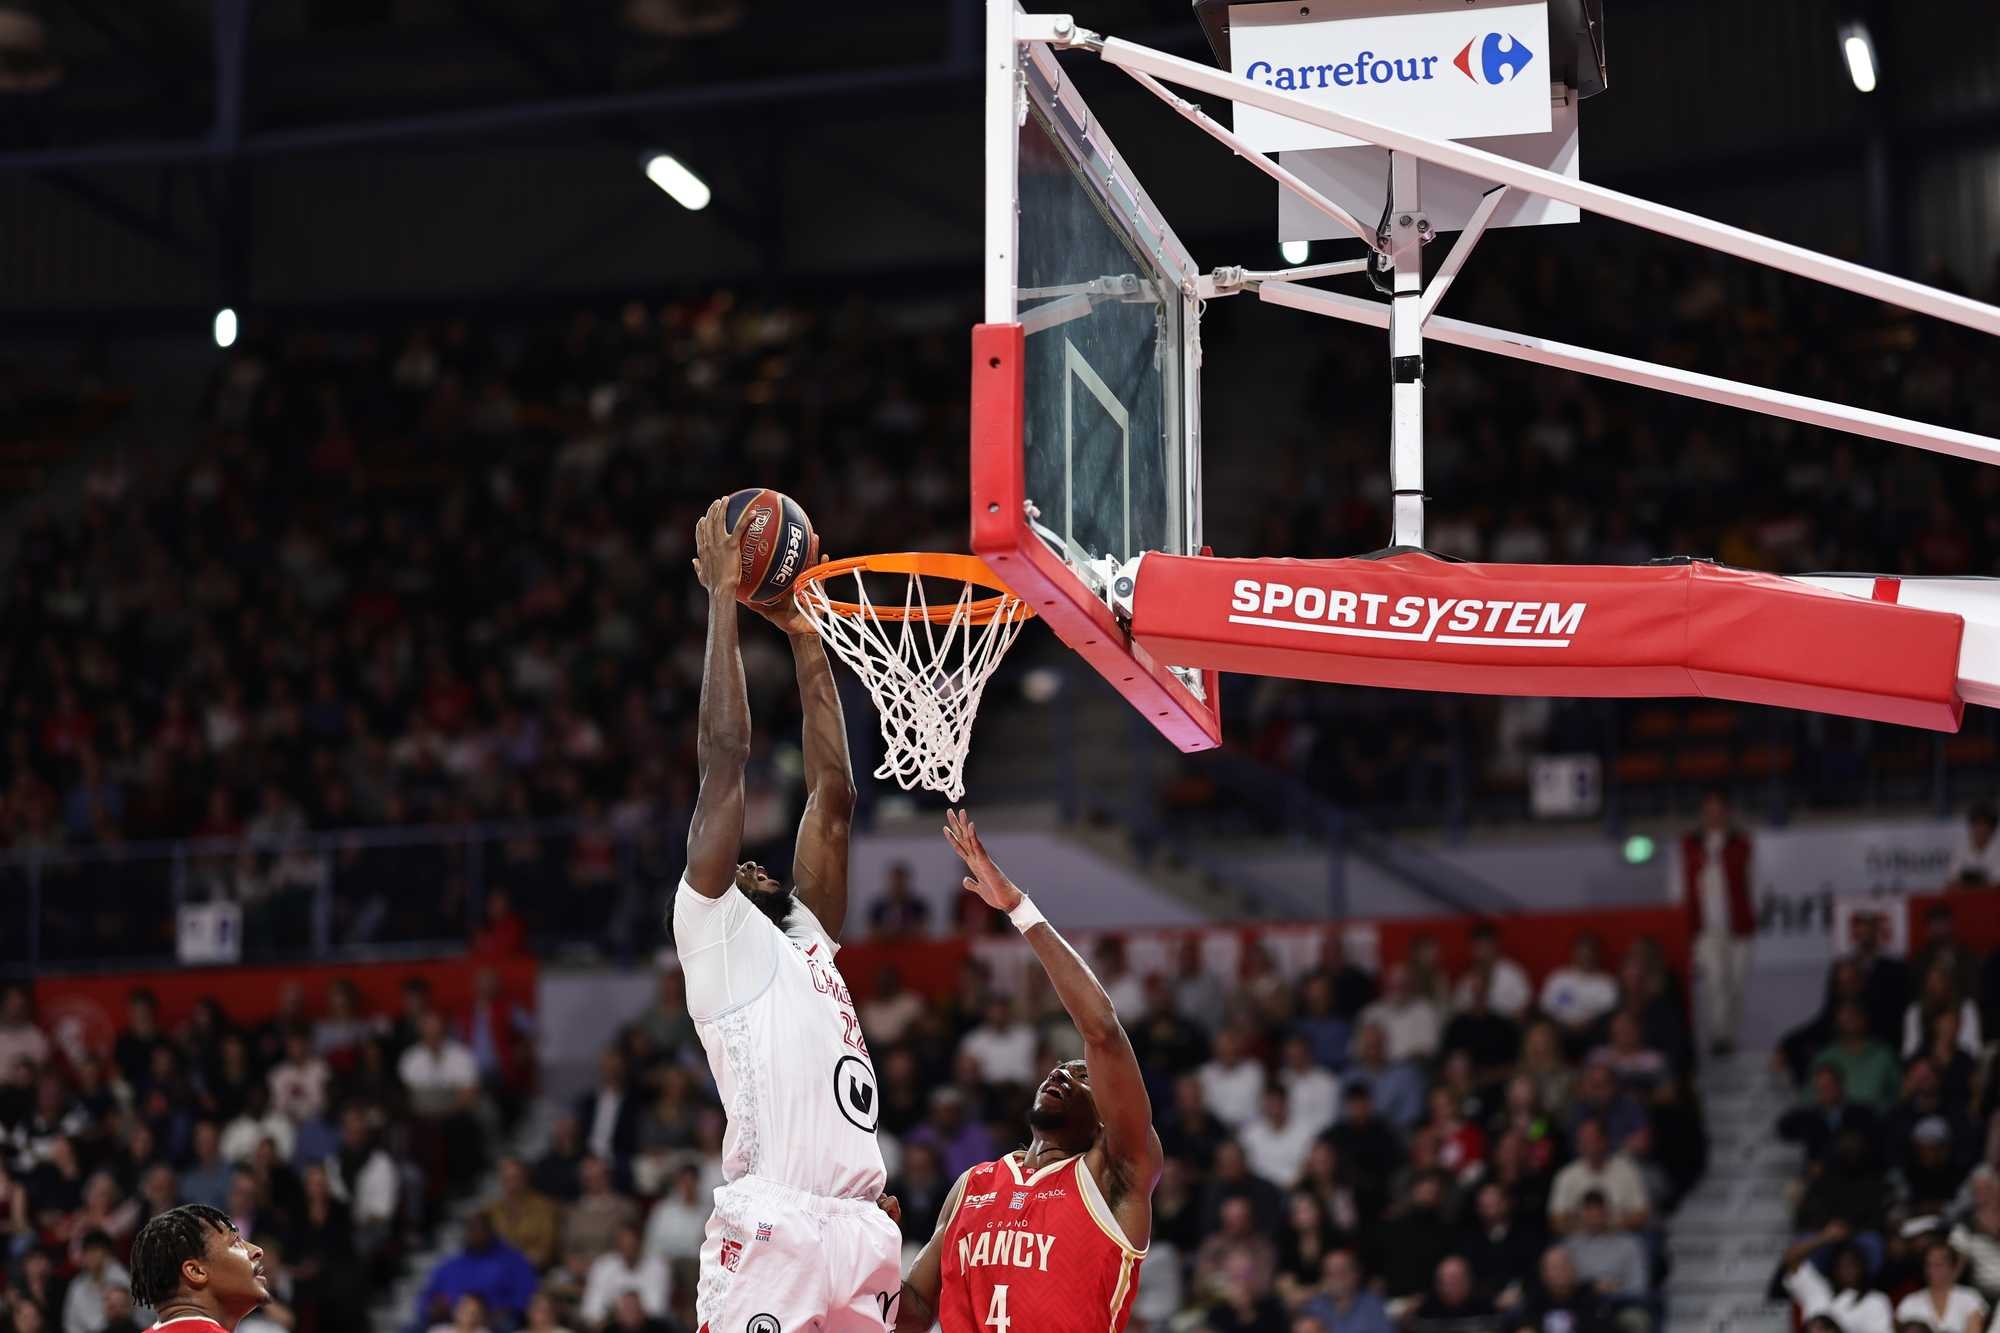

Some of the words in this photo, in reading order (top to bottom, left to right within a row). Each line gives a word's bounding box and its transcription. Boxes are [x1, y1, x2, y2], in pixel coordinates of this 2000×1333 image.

[775, 525, 803, 584] Betclic
[1232, 578, 1389, 625] SPORT
[1388, 595, 1587, 641] SYSTEM
[958, 1229, 1056, 1277] NANCY
[985, 1284, 1011, 1333] 4
